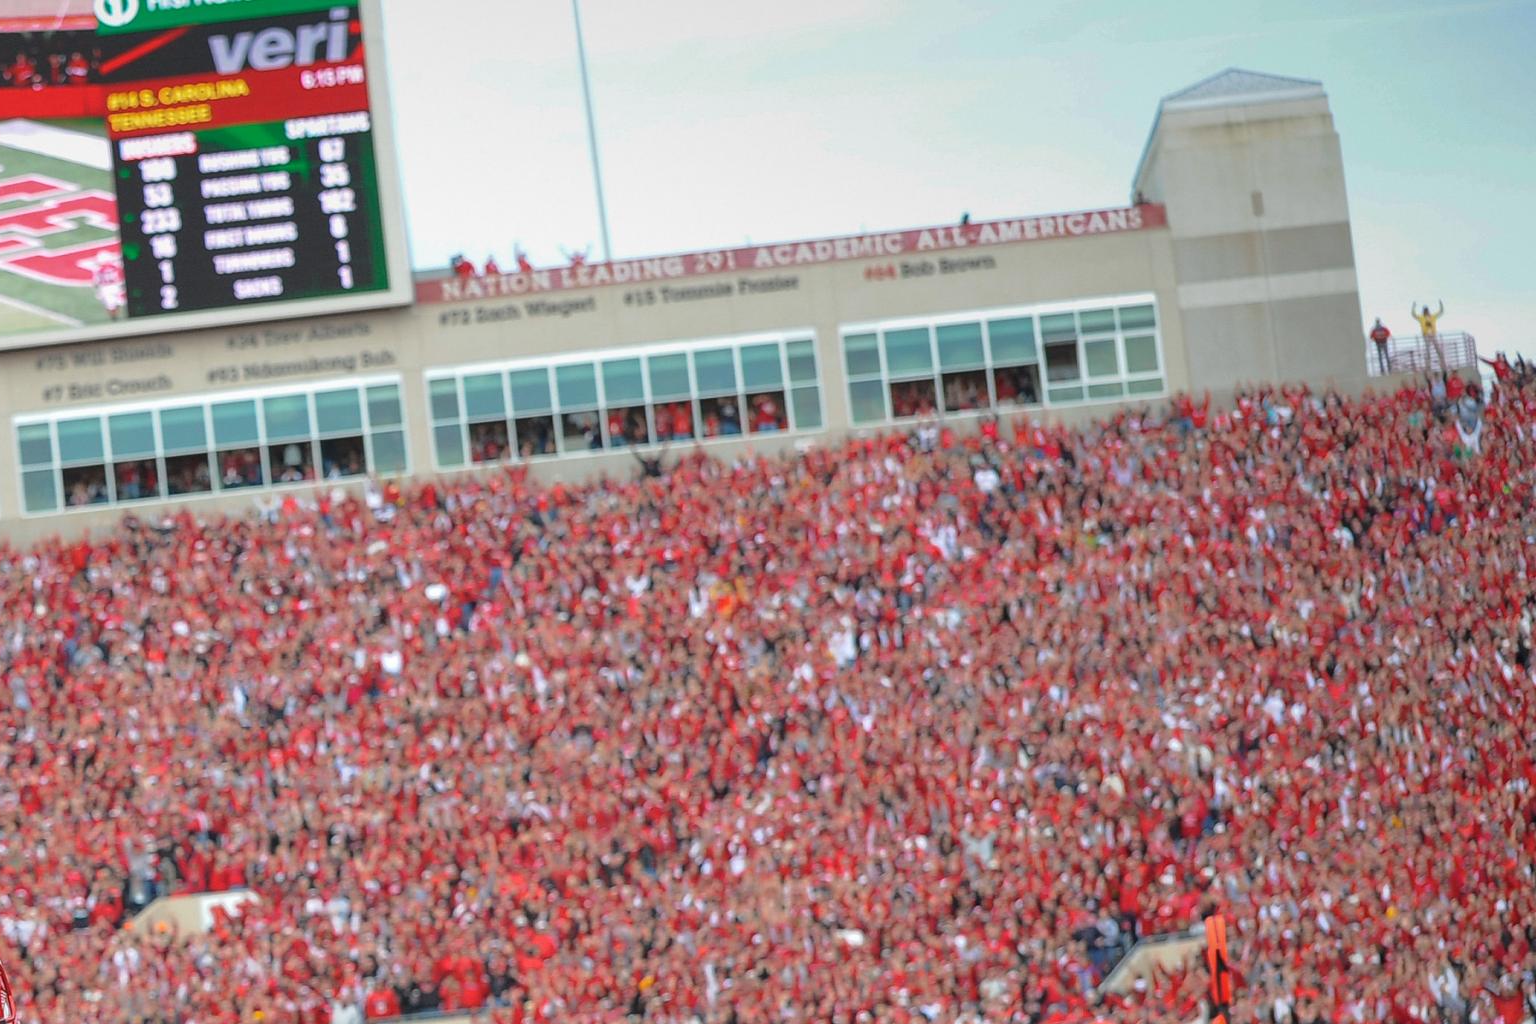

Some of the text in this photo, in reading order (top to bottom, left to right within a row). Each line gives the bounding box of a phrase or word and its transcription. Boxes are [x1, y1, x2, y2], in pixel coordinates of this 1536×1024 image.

[208, 6, 349, 75] veri
[158, 79, 250, 105] CAROLINA
[108, 104, 211, 131] TENNESSEE
[440, 271, 551, 301] NATION
[562, 256, 684, 289] LEADING
[753, 233, 905, 268] ACADEMIC
[916, 206, 1143, 252] ALL-AMERICANS
